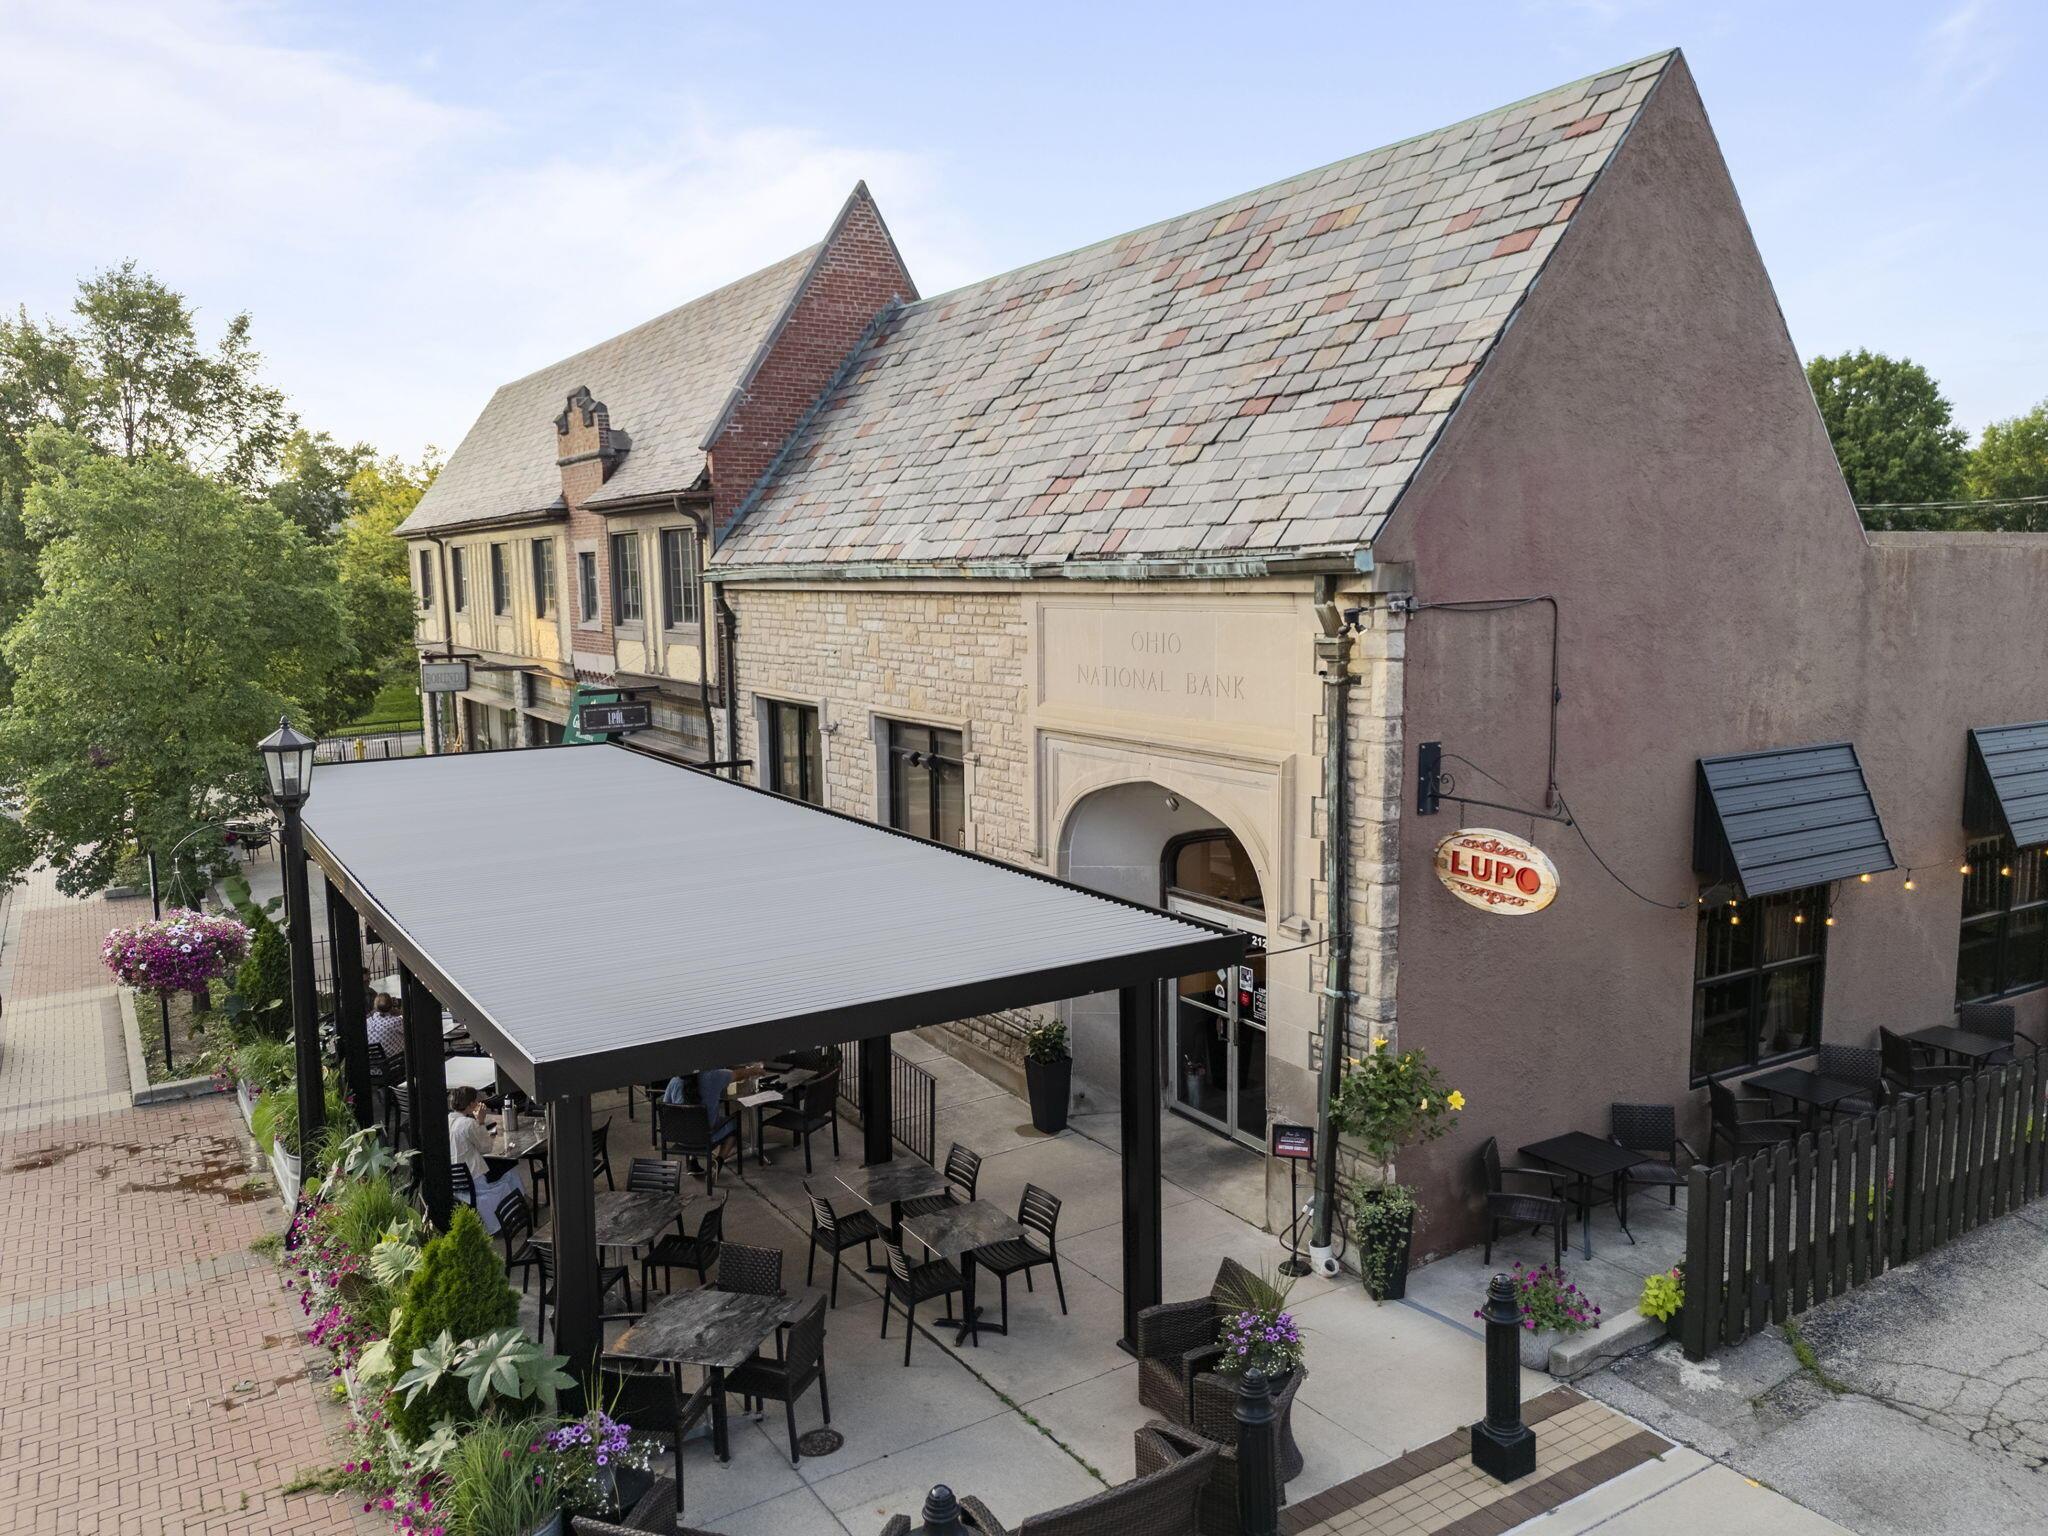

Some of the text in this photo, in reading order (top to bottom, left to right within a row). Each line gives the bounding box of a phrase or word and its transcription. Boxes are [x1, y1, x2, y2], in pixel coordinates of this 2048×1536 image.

[1131, 631, 1182, 654] OHIO
[1077, 664, 1246, 700] NATIONAL BANK
[1451, 850, 1541, 895] LUPO
